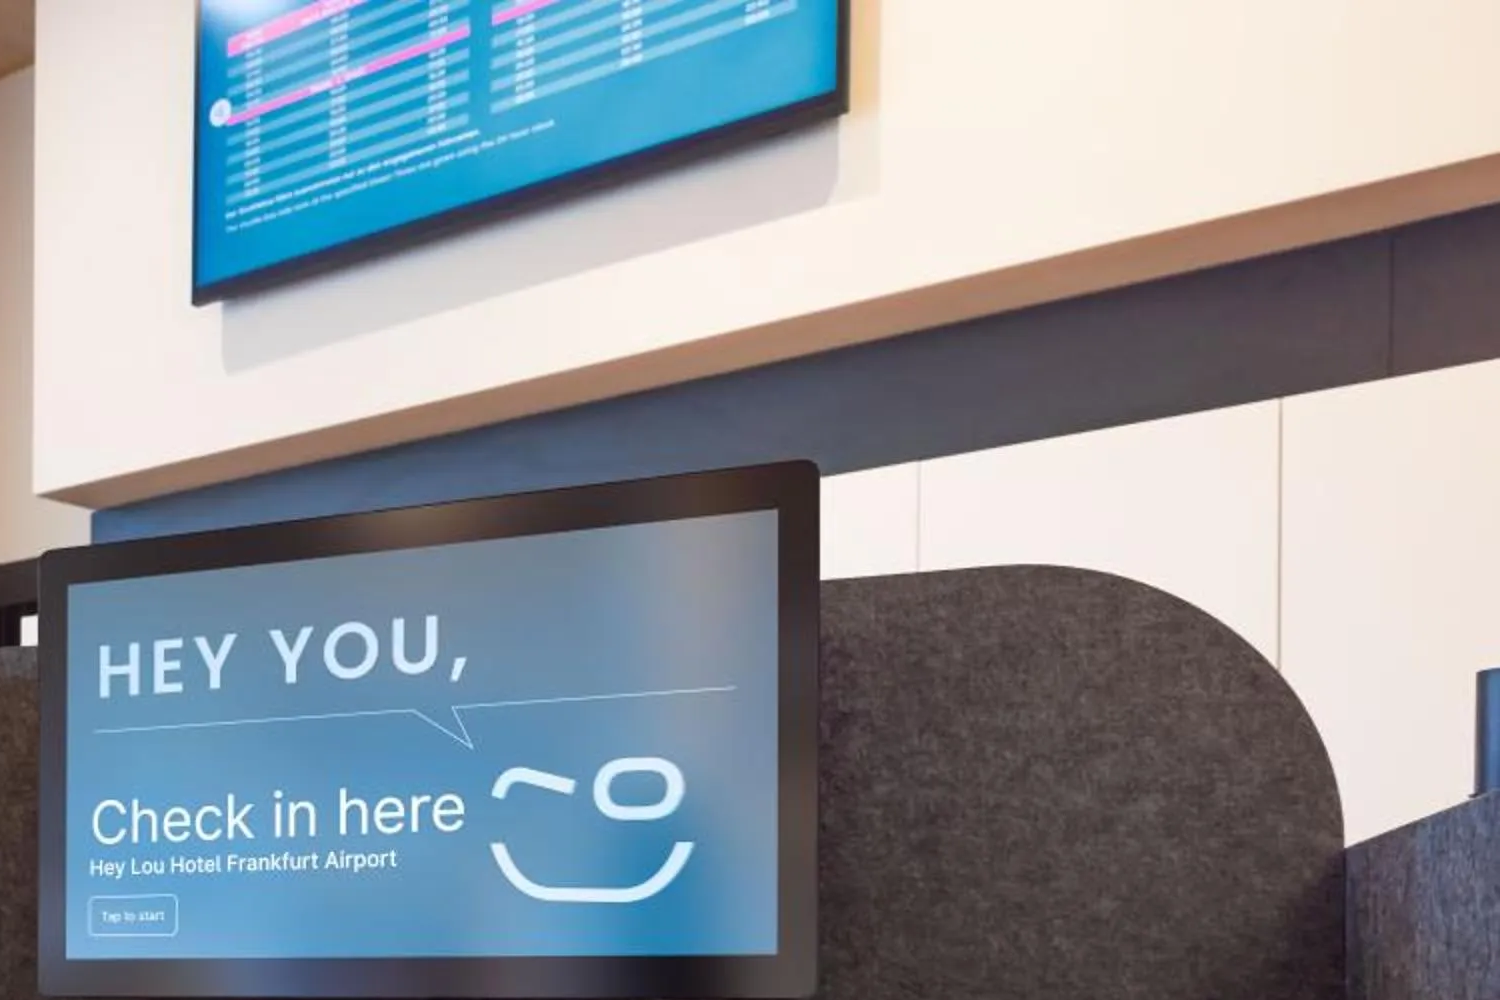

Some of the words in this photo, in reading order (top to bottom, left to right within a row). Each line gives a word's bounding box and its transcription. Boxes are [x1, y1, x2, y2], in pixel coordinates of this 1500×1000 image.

[99, 633, 238, 699] HEY
[269, 614, 468, 685] YOU,
[92, 793, 256, 846] Check
[273, 789, 318, 839] in
[339, 788, 466, 836] here
[90, 858, 124, 879] Hey
[131, 858, 166, 876] Lou
[170, 855, 222, 874] Hotel
[227, 850, 319, 872] Frankfurt
[325, 849, 398, 873] Airport
[138, 910, 165, 922] start
